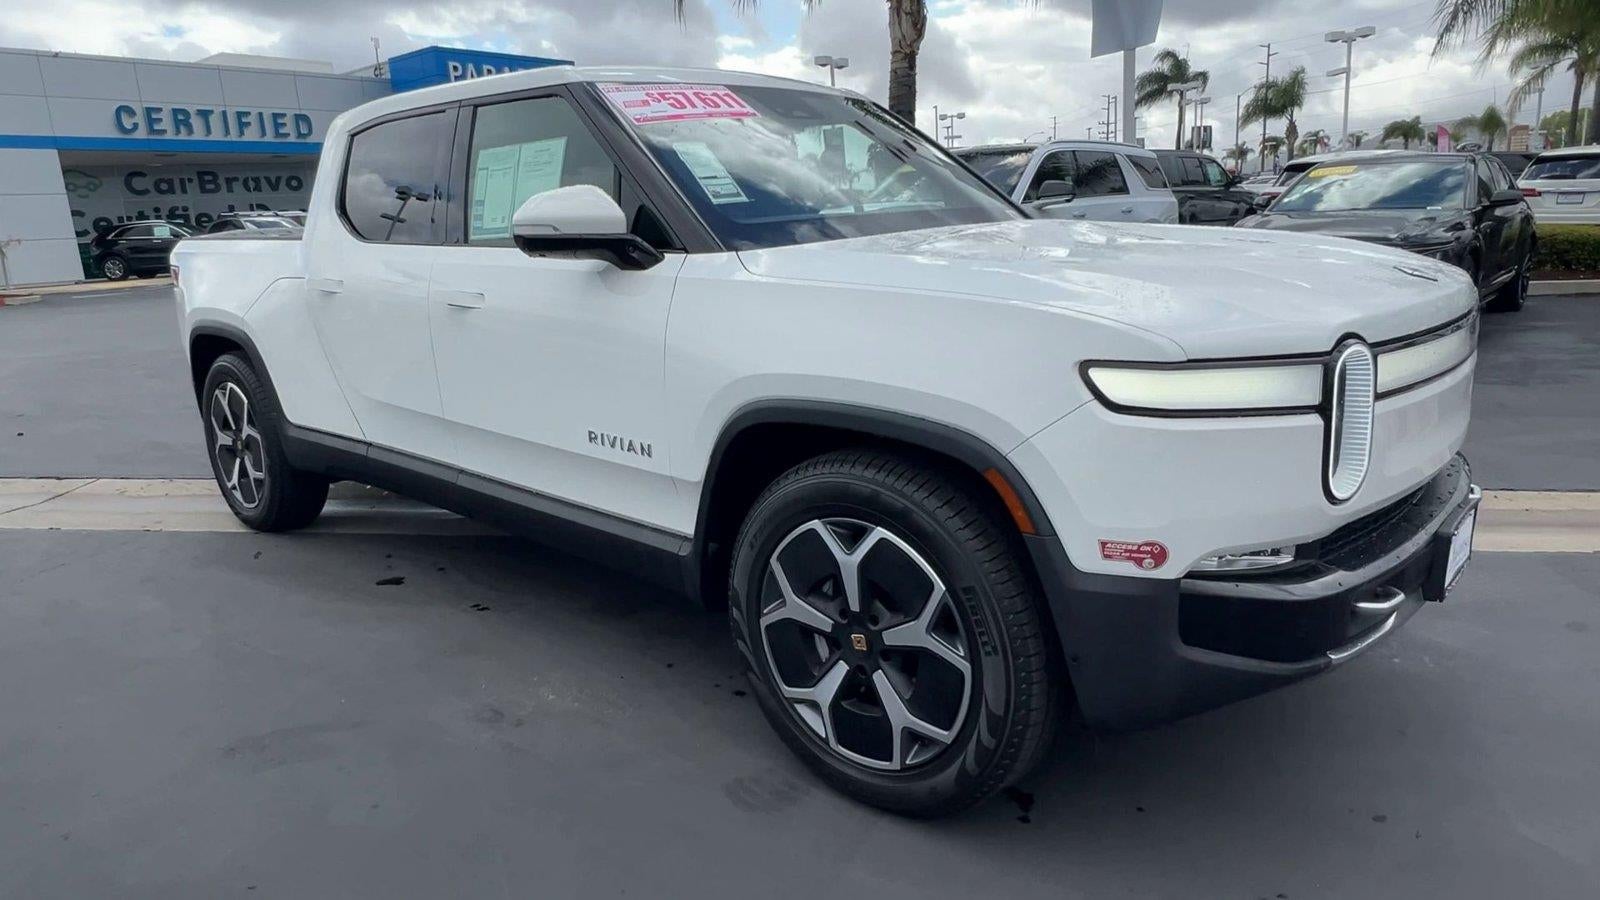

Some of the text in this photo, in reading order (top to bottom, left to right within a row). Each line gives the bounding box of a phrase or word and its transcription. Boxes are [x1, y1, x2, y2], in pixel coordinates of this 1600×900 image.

[114, 104, 313, 139] CERTIFIED
[123, 170, 304, 196] CarBravo
[587, 429, 653, 458] RIVIAN
